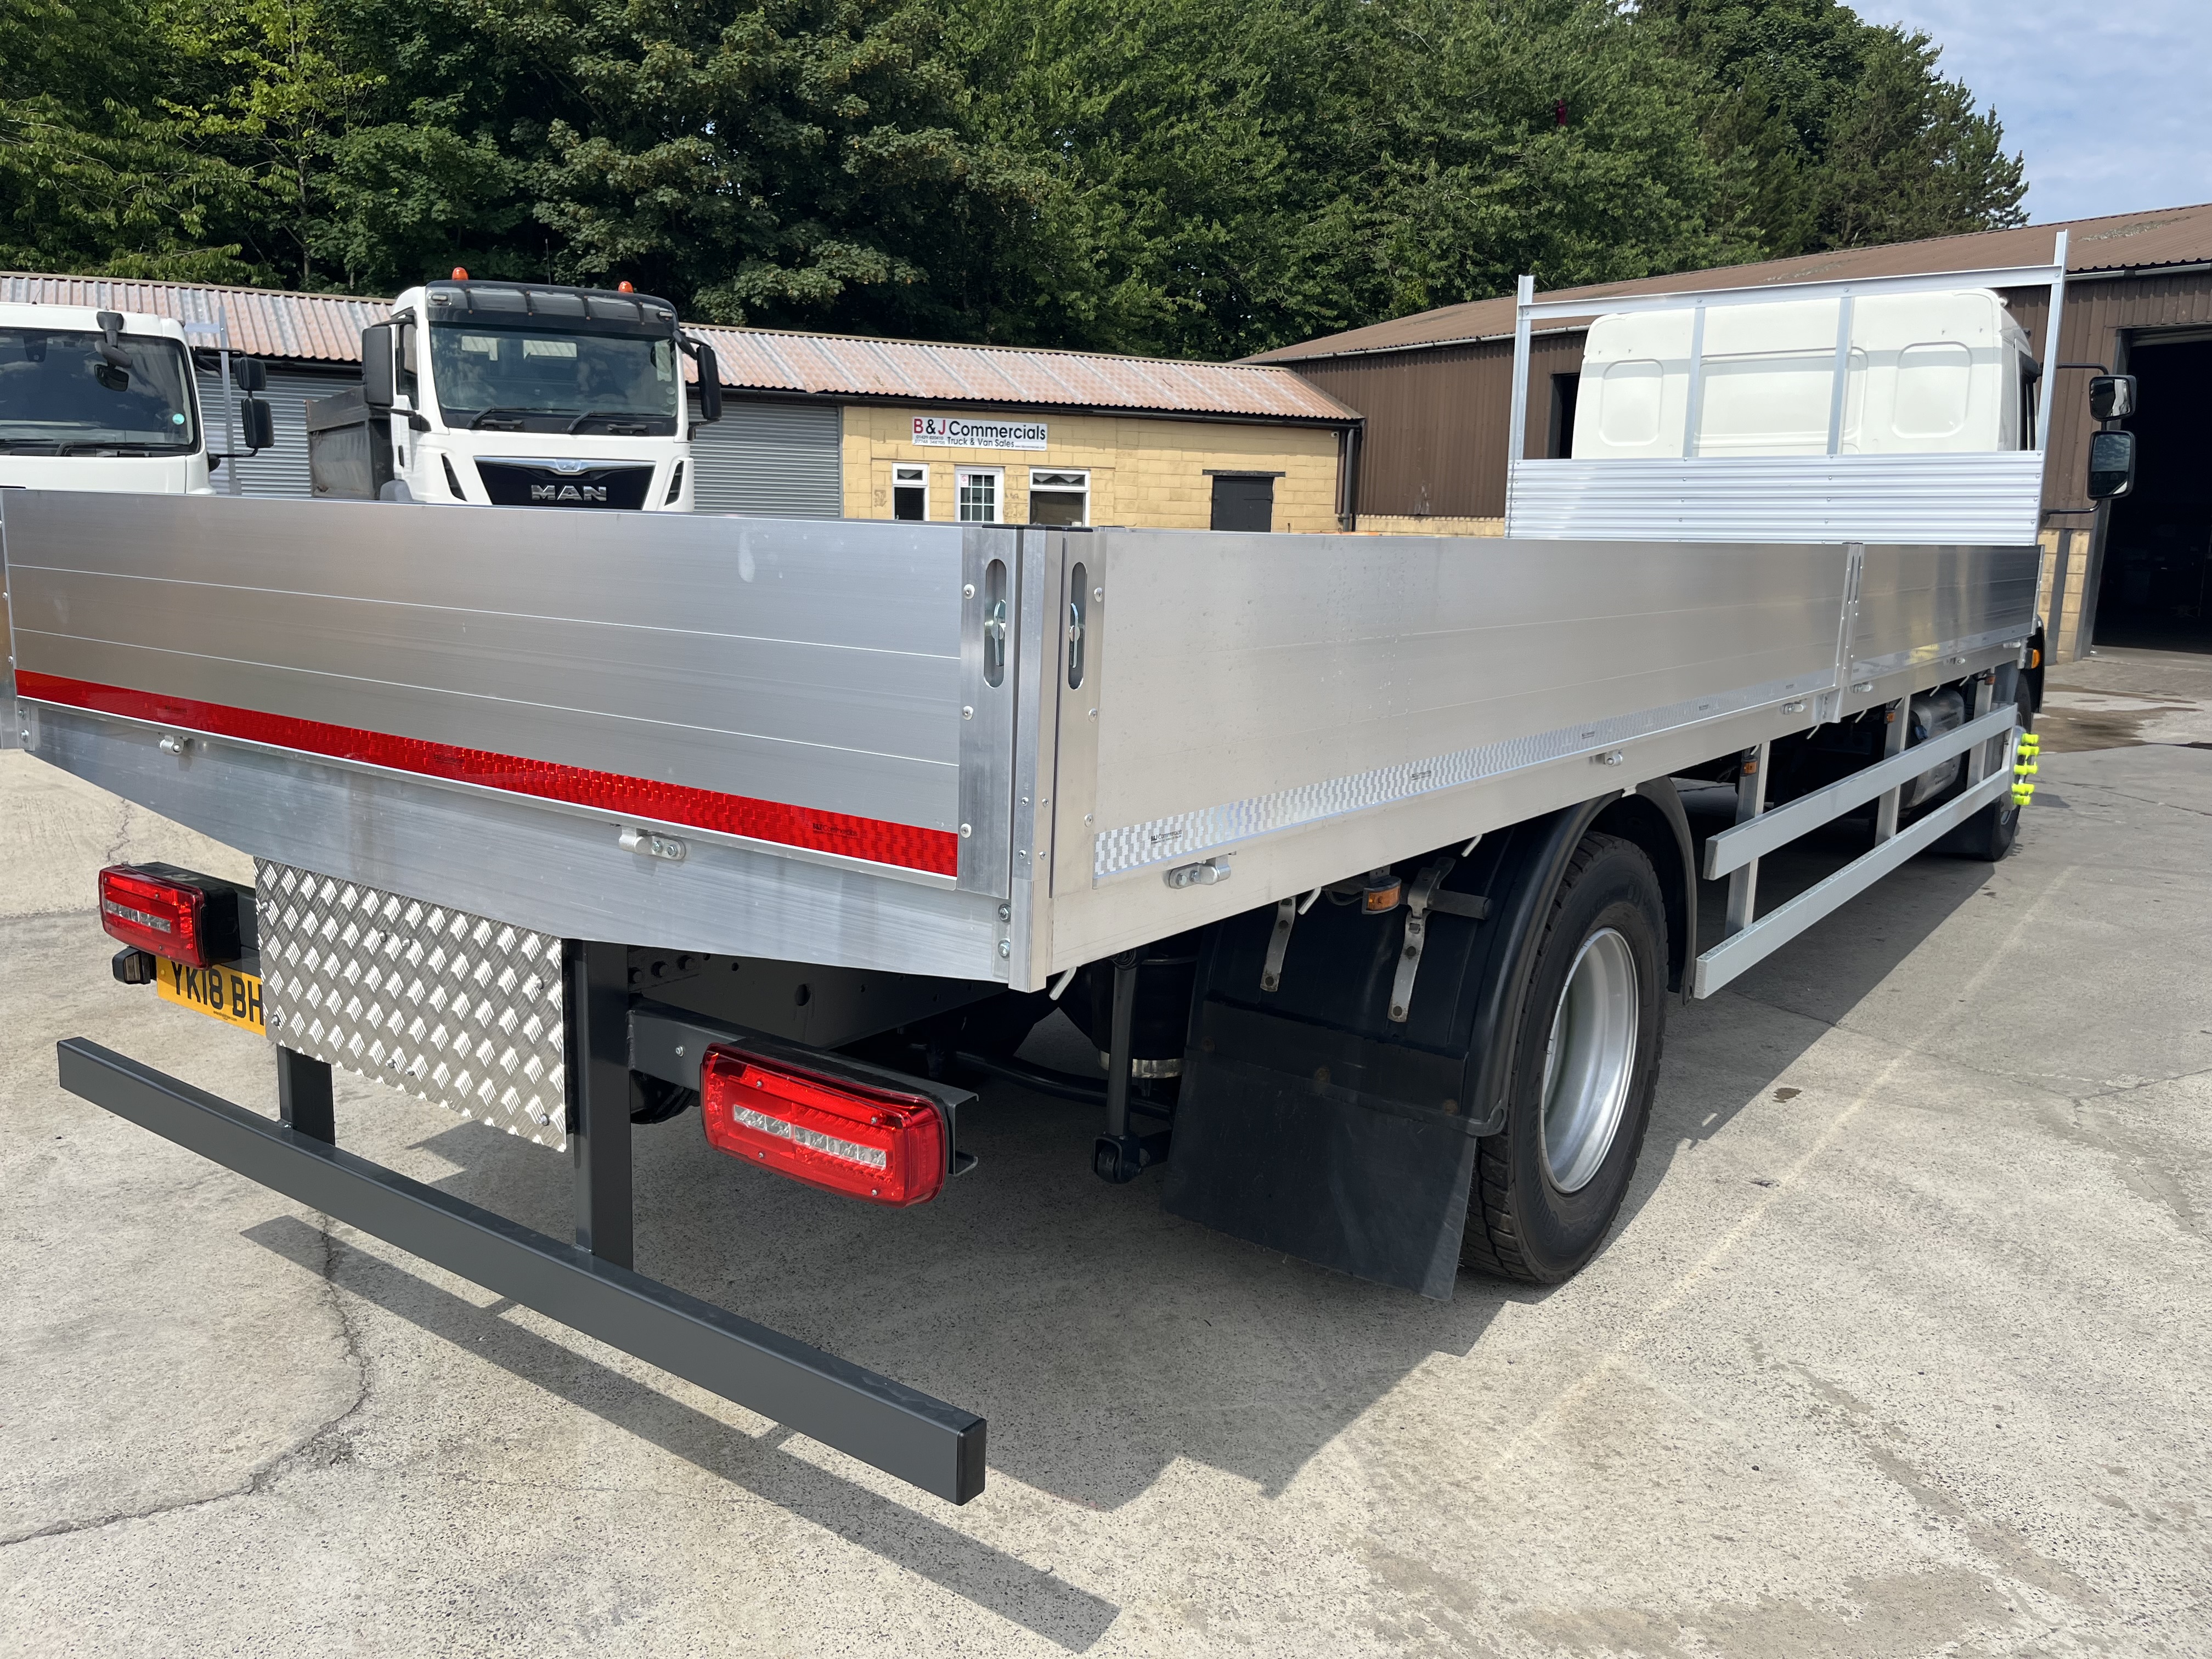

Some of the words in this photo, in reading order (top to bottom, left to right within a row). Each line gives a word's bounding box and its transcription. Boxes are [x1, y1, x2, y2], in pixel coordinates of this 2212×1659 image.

[913, 419, 923, 433] B
[926, 419, 936, 435] &
[938, 420, 946, 435] J
[949, 421, 1046, 440] Commercials
[947, 437, 968, 445] Truck
[970, 437, 975, 445] &
[995, 439, 1014, 447] Sales
[531, 484, 607, 501] MAN
[171, 961, 224, 1010] YK18
[230, 974, 264, 1026] BH
